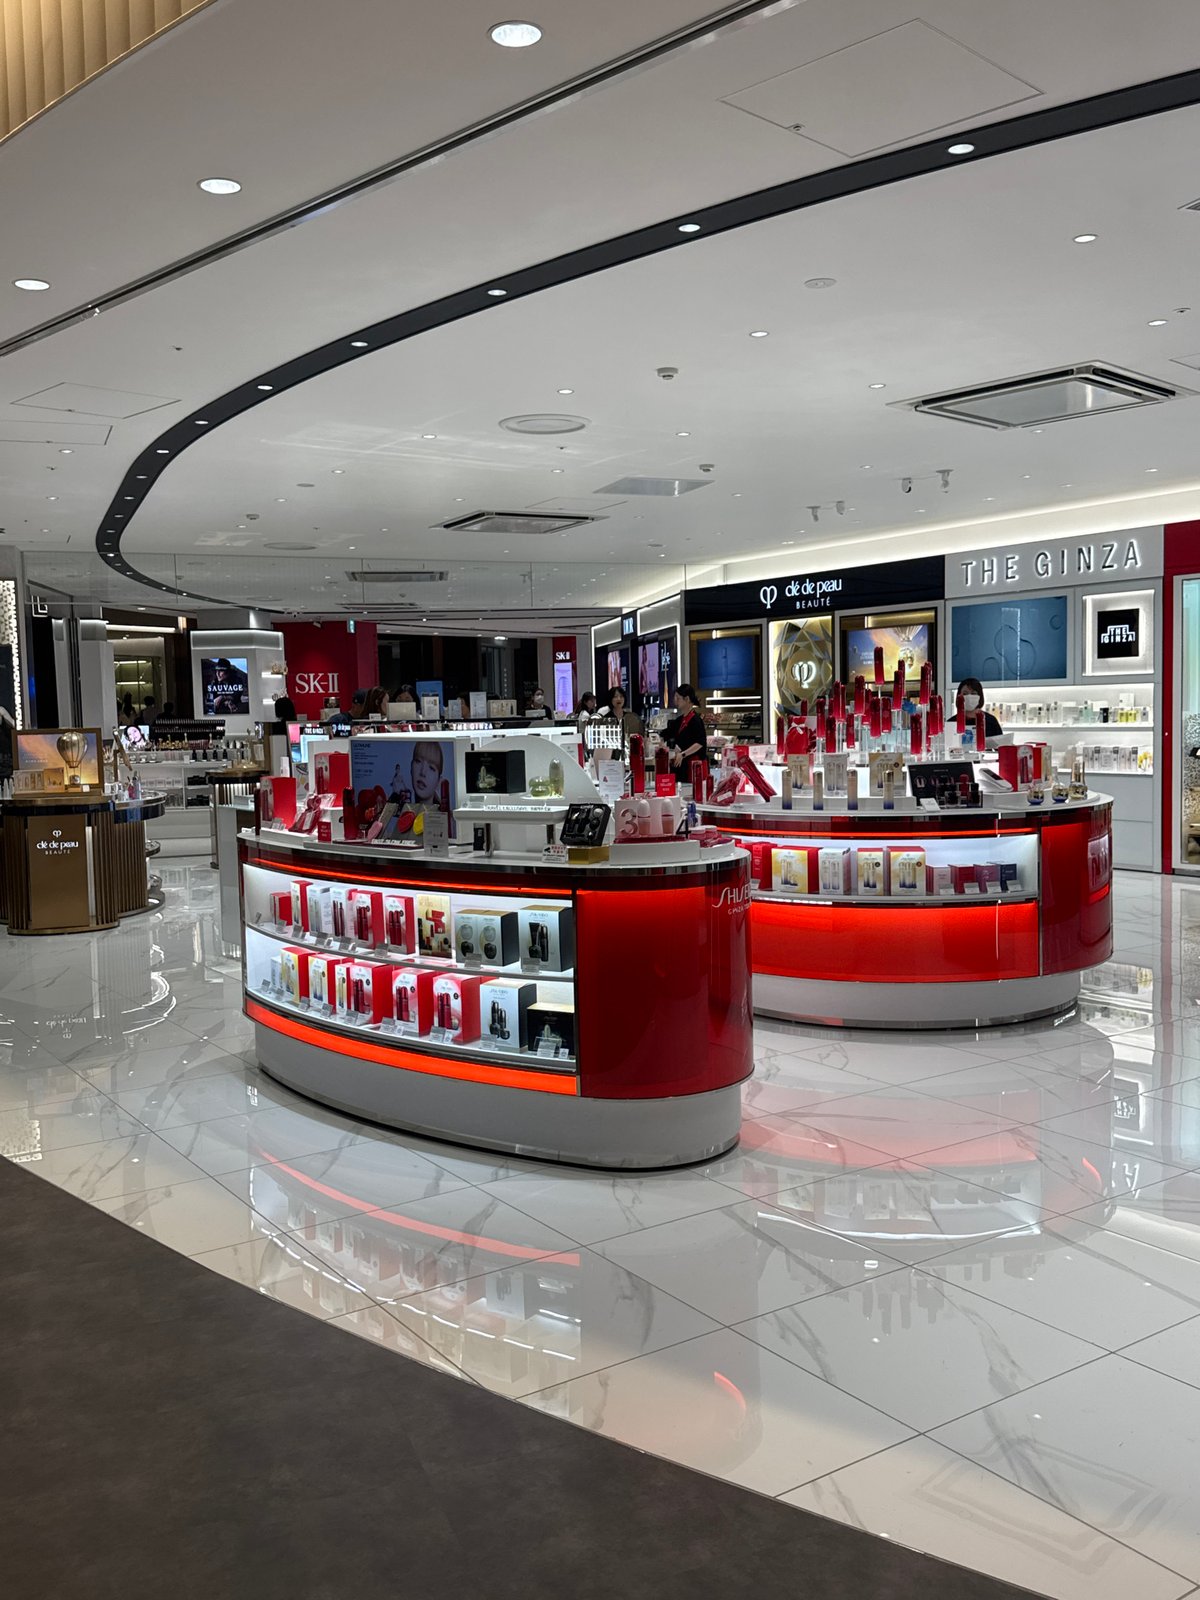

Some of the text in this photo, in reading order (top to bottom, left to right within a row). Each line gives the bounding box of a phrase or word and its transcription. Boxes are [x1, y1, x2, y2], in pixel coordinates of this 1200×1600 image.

[961, 539, 1142, 587] THE GINZA
[801, 578, 815, 595] de
[816, 579, 842, 598] peau
[796, 596, 831, 609] BEAUTÉ
[1110, 627, 1127, 635] THE
[1103, 635, 1133, 643] GINZA
[207, 684, 244, 692] SAUVAGE
[295, 672, 340, 694] SK-II
[620, 808, 639, 835] 3
[49, 840, 59, 849] de
[60, 841, 79, 850] peau
